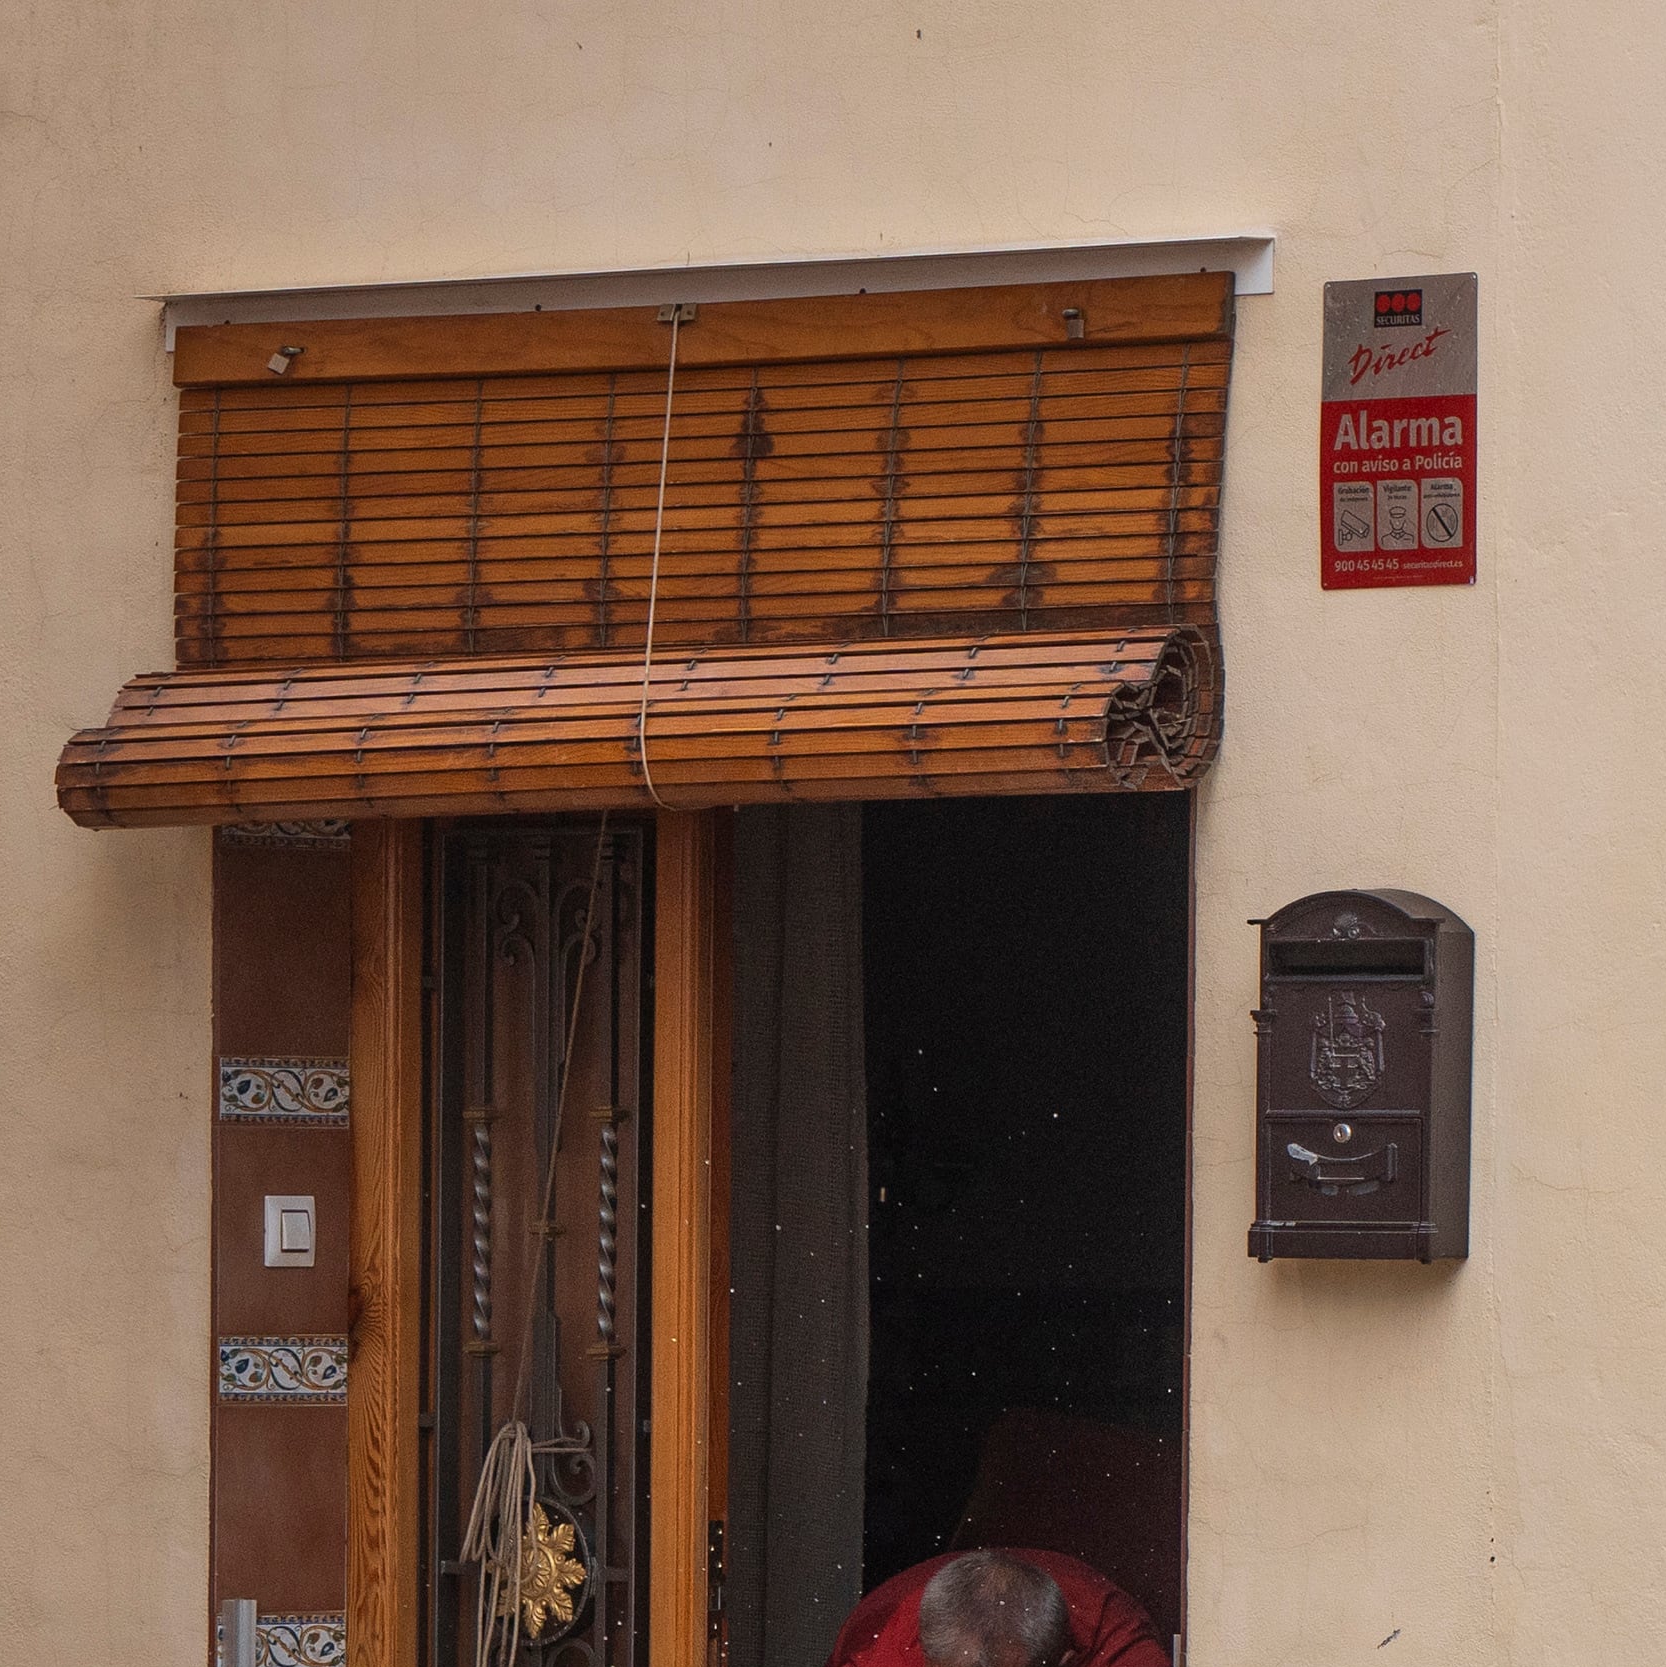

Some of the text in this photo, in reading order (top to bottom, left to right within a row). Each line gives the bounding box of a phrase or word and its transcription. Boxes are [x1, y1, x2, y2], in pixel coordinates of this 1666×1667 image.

[1376, 313, 1421, 326] SECURITAS
[1347, 326, 1452, 385] Direct
[1334, 410, 1463, 450] Alarma
[1334, 451, 1462, 474] con aviso a Policía
[1334, 560, 1354, 572] 900
[1357, 560, 1370, 571] 45
[1372, 559, 1384, 570] 45
[1386, 558, 1399, 570] 45
